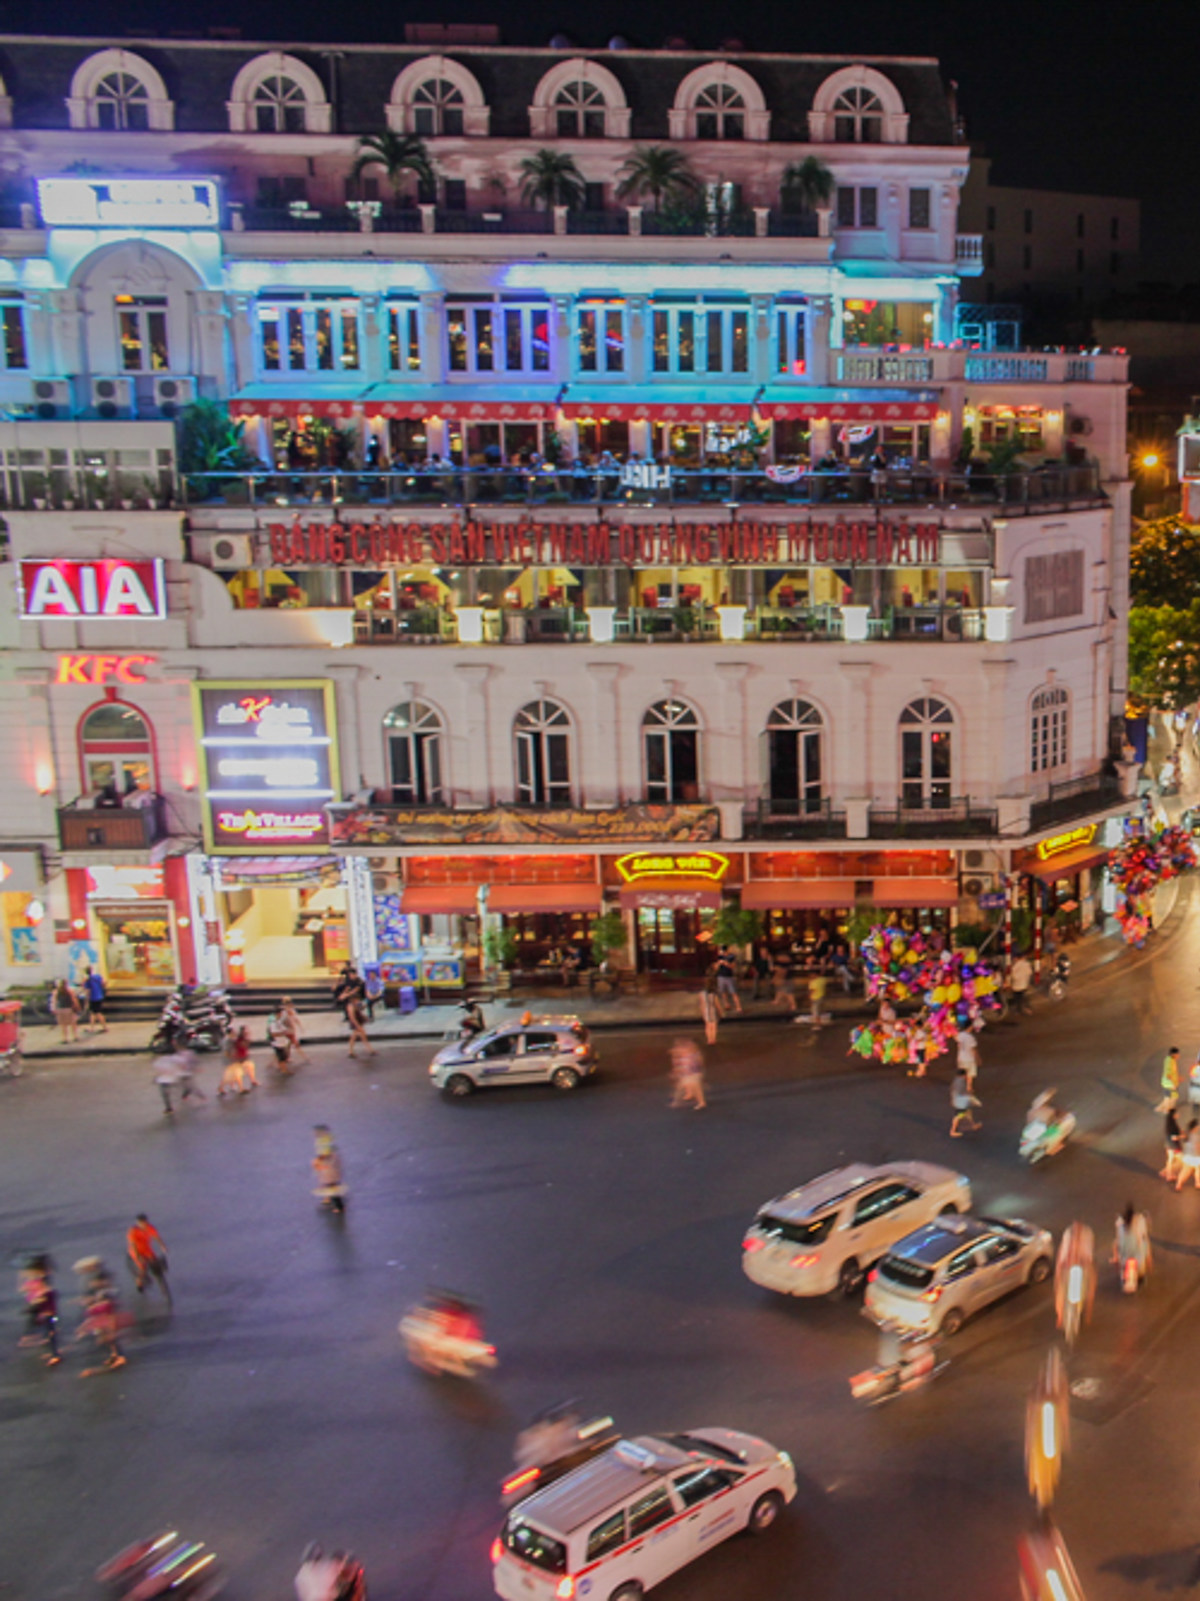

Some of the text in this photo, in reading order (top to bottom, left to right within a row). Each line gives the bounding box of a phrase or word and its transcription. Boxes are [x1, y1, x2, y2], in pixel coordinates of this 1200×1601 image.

[269, 513, 346, 564] ĐẢNG
[430, 513, 486, 563] SẢN
[549, 522, 611, 563] NAM
[618, 523, 711, 565] QUANG
[718, 522, 779, 562] VINH
[787, 513, 868, 562] MUÔN
[876, 515, 939, 563] NĂM
[28, 566, 155, 613] AIA
[55, 655, 149, 684] KFC
